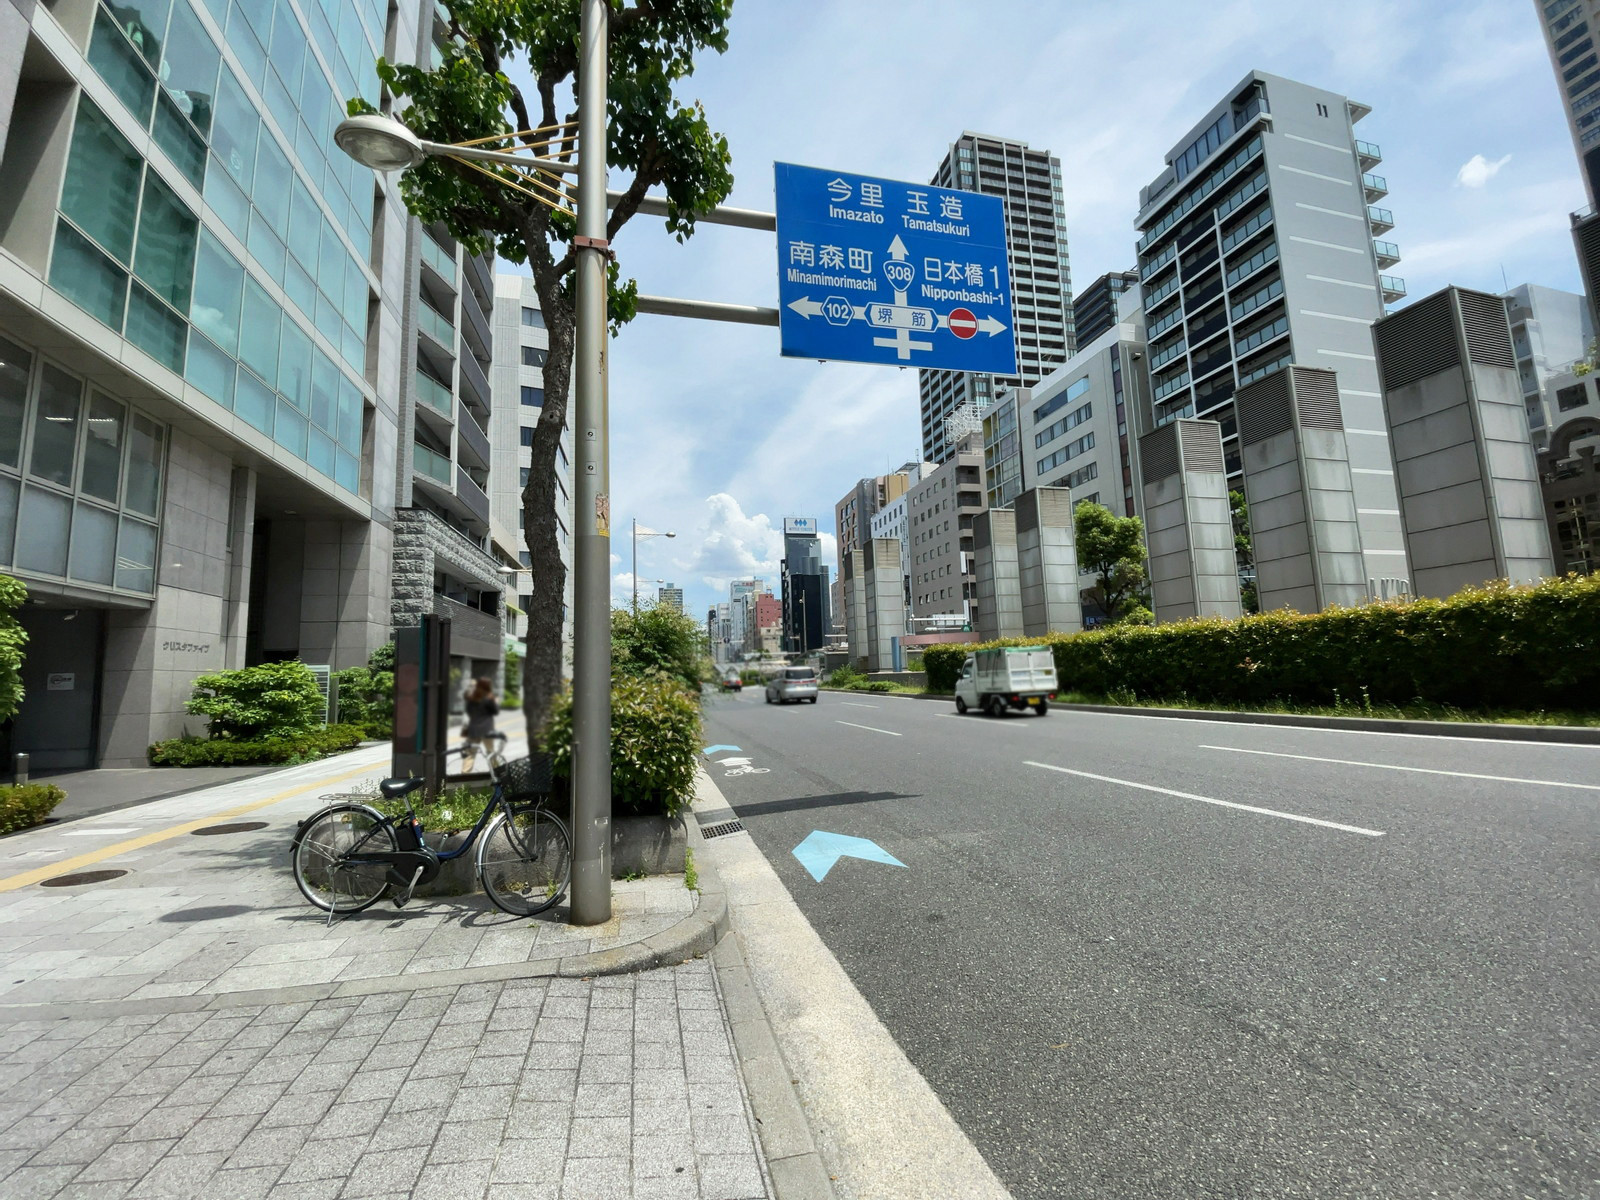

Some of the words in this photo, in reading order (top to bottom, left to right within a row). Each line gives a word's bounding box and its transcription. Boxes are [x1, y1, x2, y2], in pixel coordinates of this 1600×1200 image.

[827, 177, 885, 209] 今里
[828, 204, 885, 225] Imazato
[906, 190, 964, 221] 玉造
[901, 215, 970, 237] Tamatsukuri
[789, 240, 873, 274] 南森町
[787, 268, 877, 292] Minamimorimachi
[887, 265, 911, 281] 308
[921, 284, 1004, 306] Nipponbashi-1
[826, 303, 850, 319] 102
